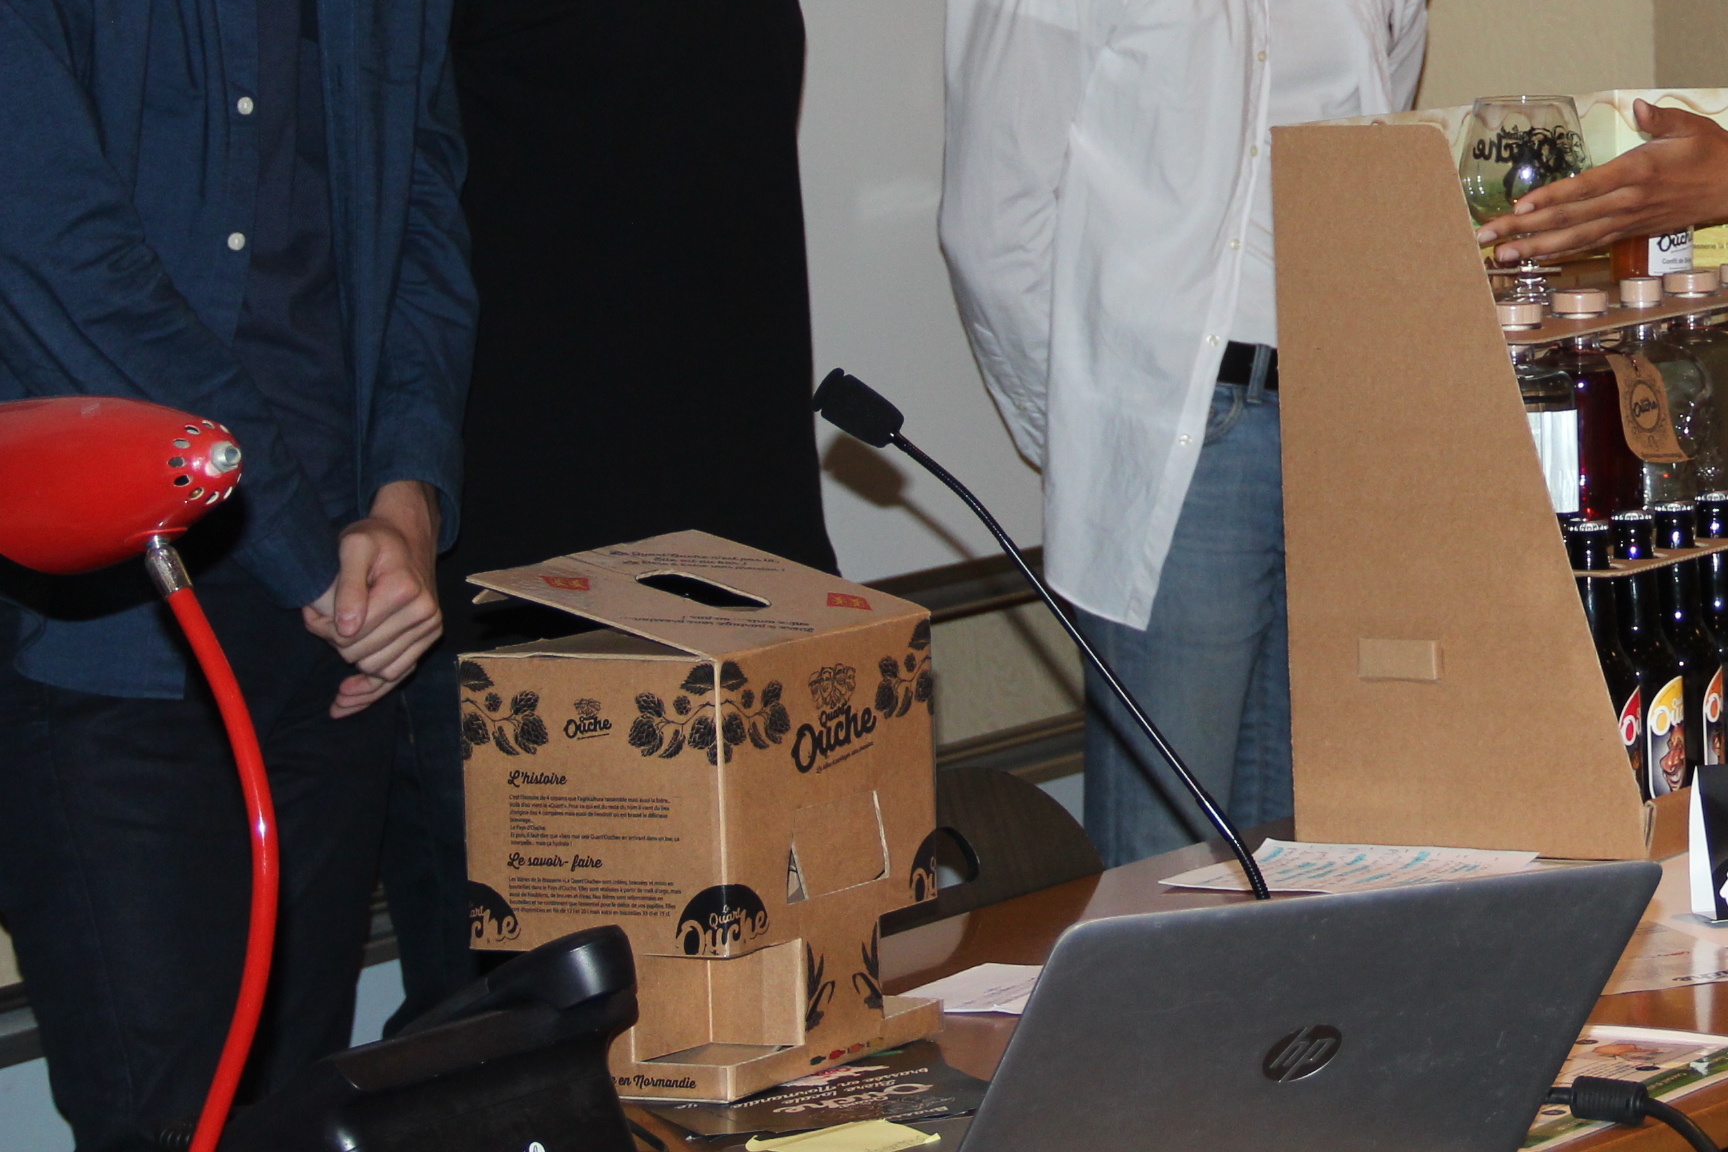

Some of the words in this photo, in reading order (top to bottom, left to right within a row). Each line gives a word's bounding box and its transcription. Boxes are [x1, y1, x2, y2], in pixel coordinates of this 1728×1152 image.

[563, 715, 613, 740] Ouche
[791, 705, 877, 773] Ouche
[507, 770, 567, 788] L'histoire
[507, 851, 525, 869] Le
[570, 854, 603, 872] faire
[676, 909, 770, 956] Ouche
[1268, 1026, 1337, 1084] hp
[618, 1076, 632, 1086] en
[633, 1074, 698, 1090] Normandie
[836, 1078, 860, 1088] en
[843, 1078, 897, 1093] Bière
[860, 1067, 930, 1083] brassée
[728, 1085, 838, 1110] Normandie
[773, 1083, 935, 1115] Ouche
[781, 1090, 838, 1105] locale
